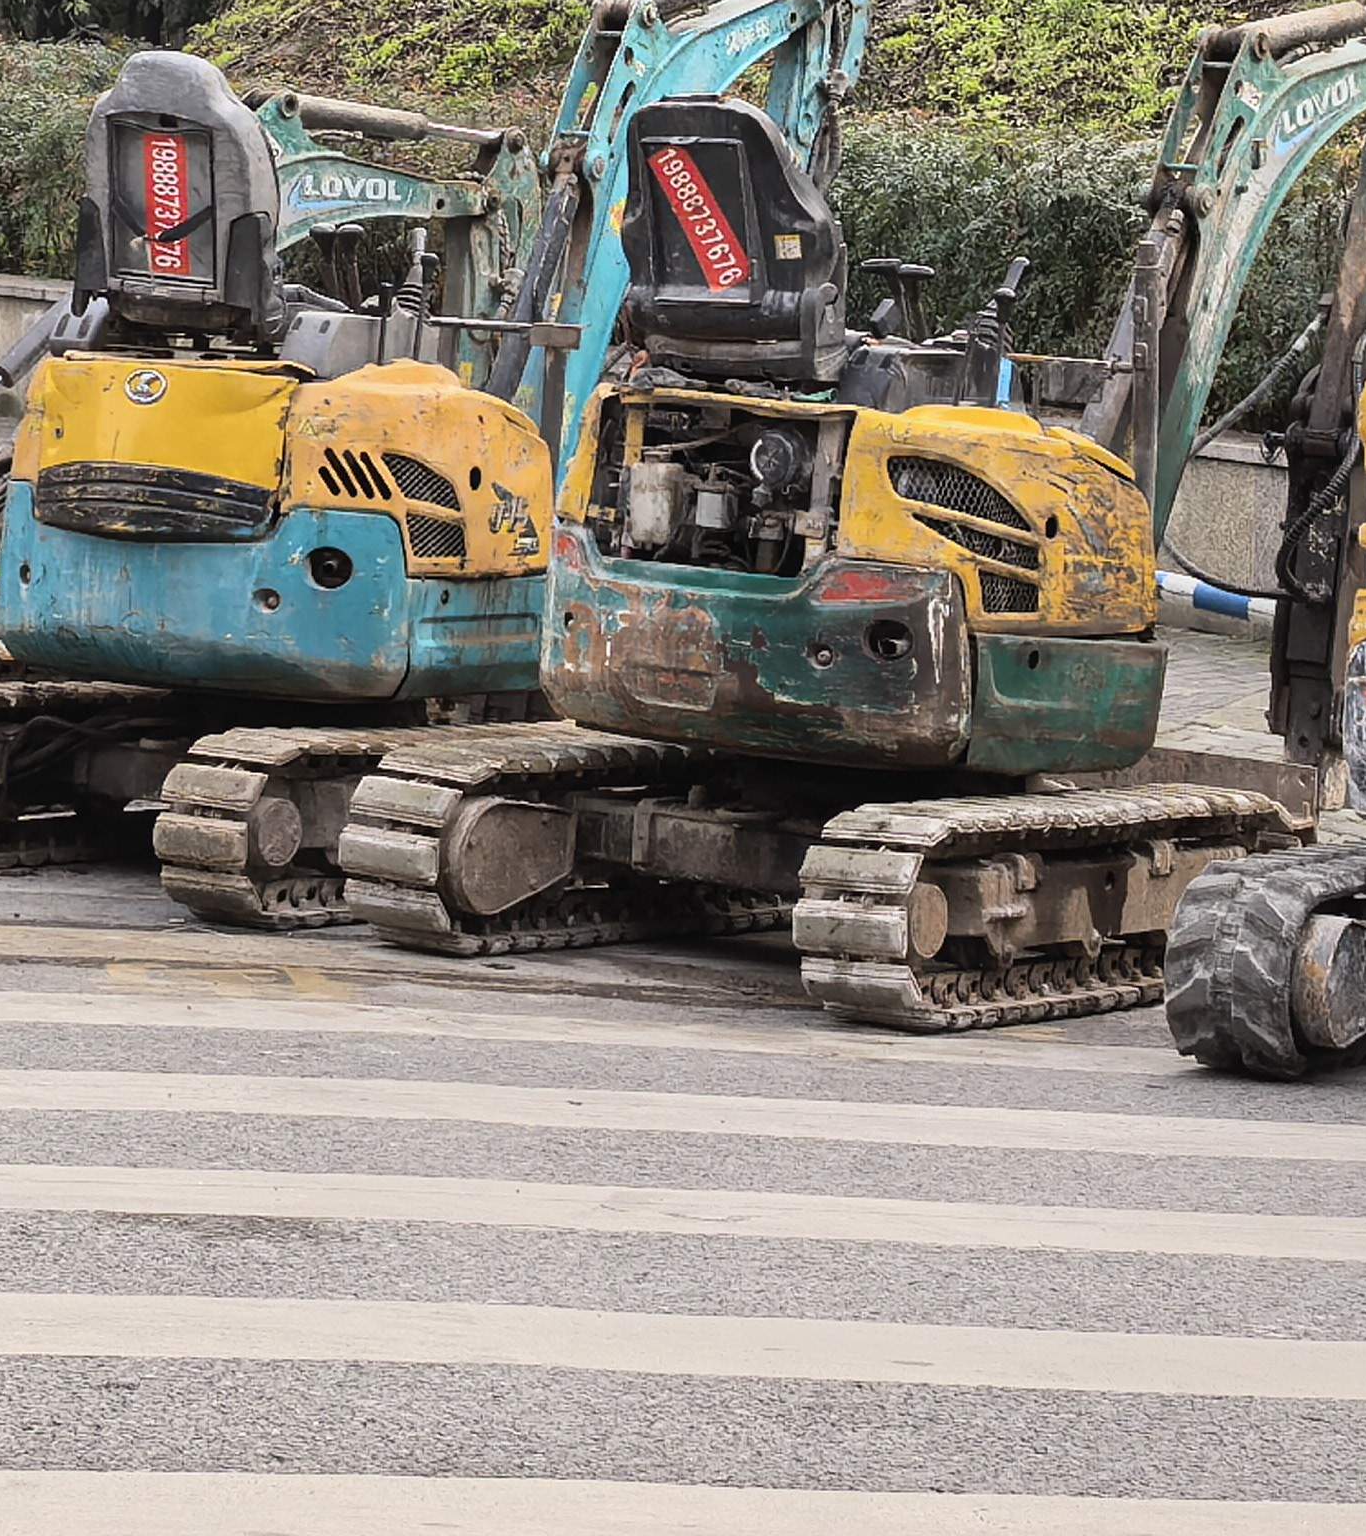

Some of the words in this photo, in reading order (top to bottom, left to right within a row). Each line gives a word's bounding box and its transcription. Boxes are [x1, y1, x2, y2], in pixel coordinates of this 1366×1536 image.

[1281, 72, 1362, 135] LOVOL
[150, 137, 182, 269] 1988873776
[302, 174, 402, 201] LOVOL
[657, 148, 743, 285] 19888737676
